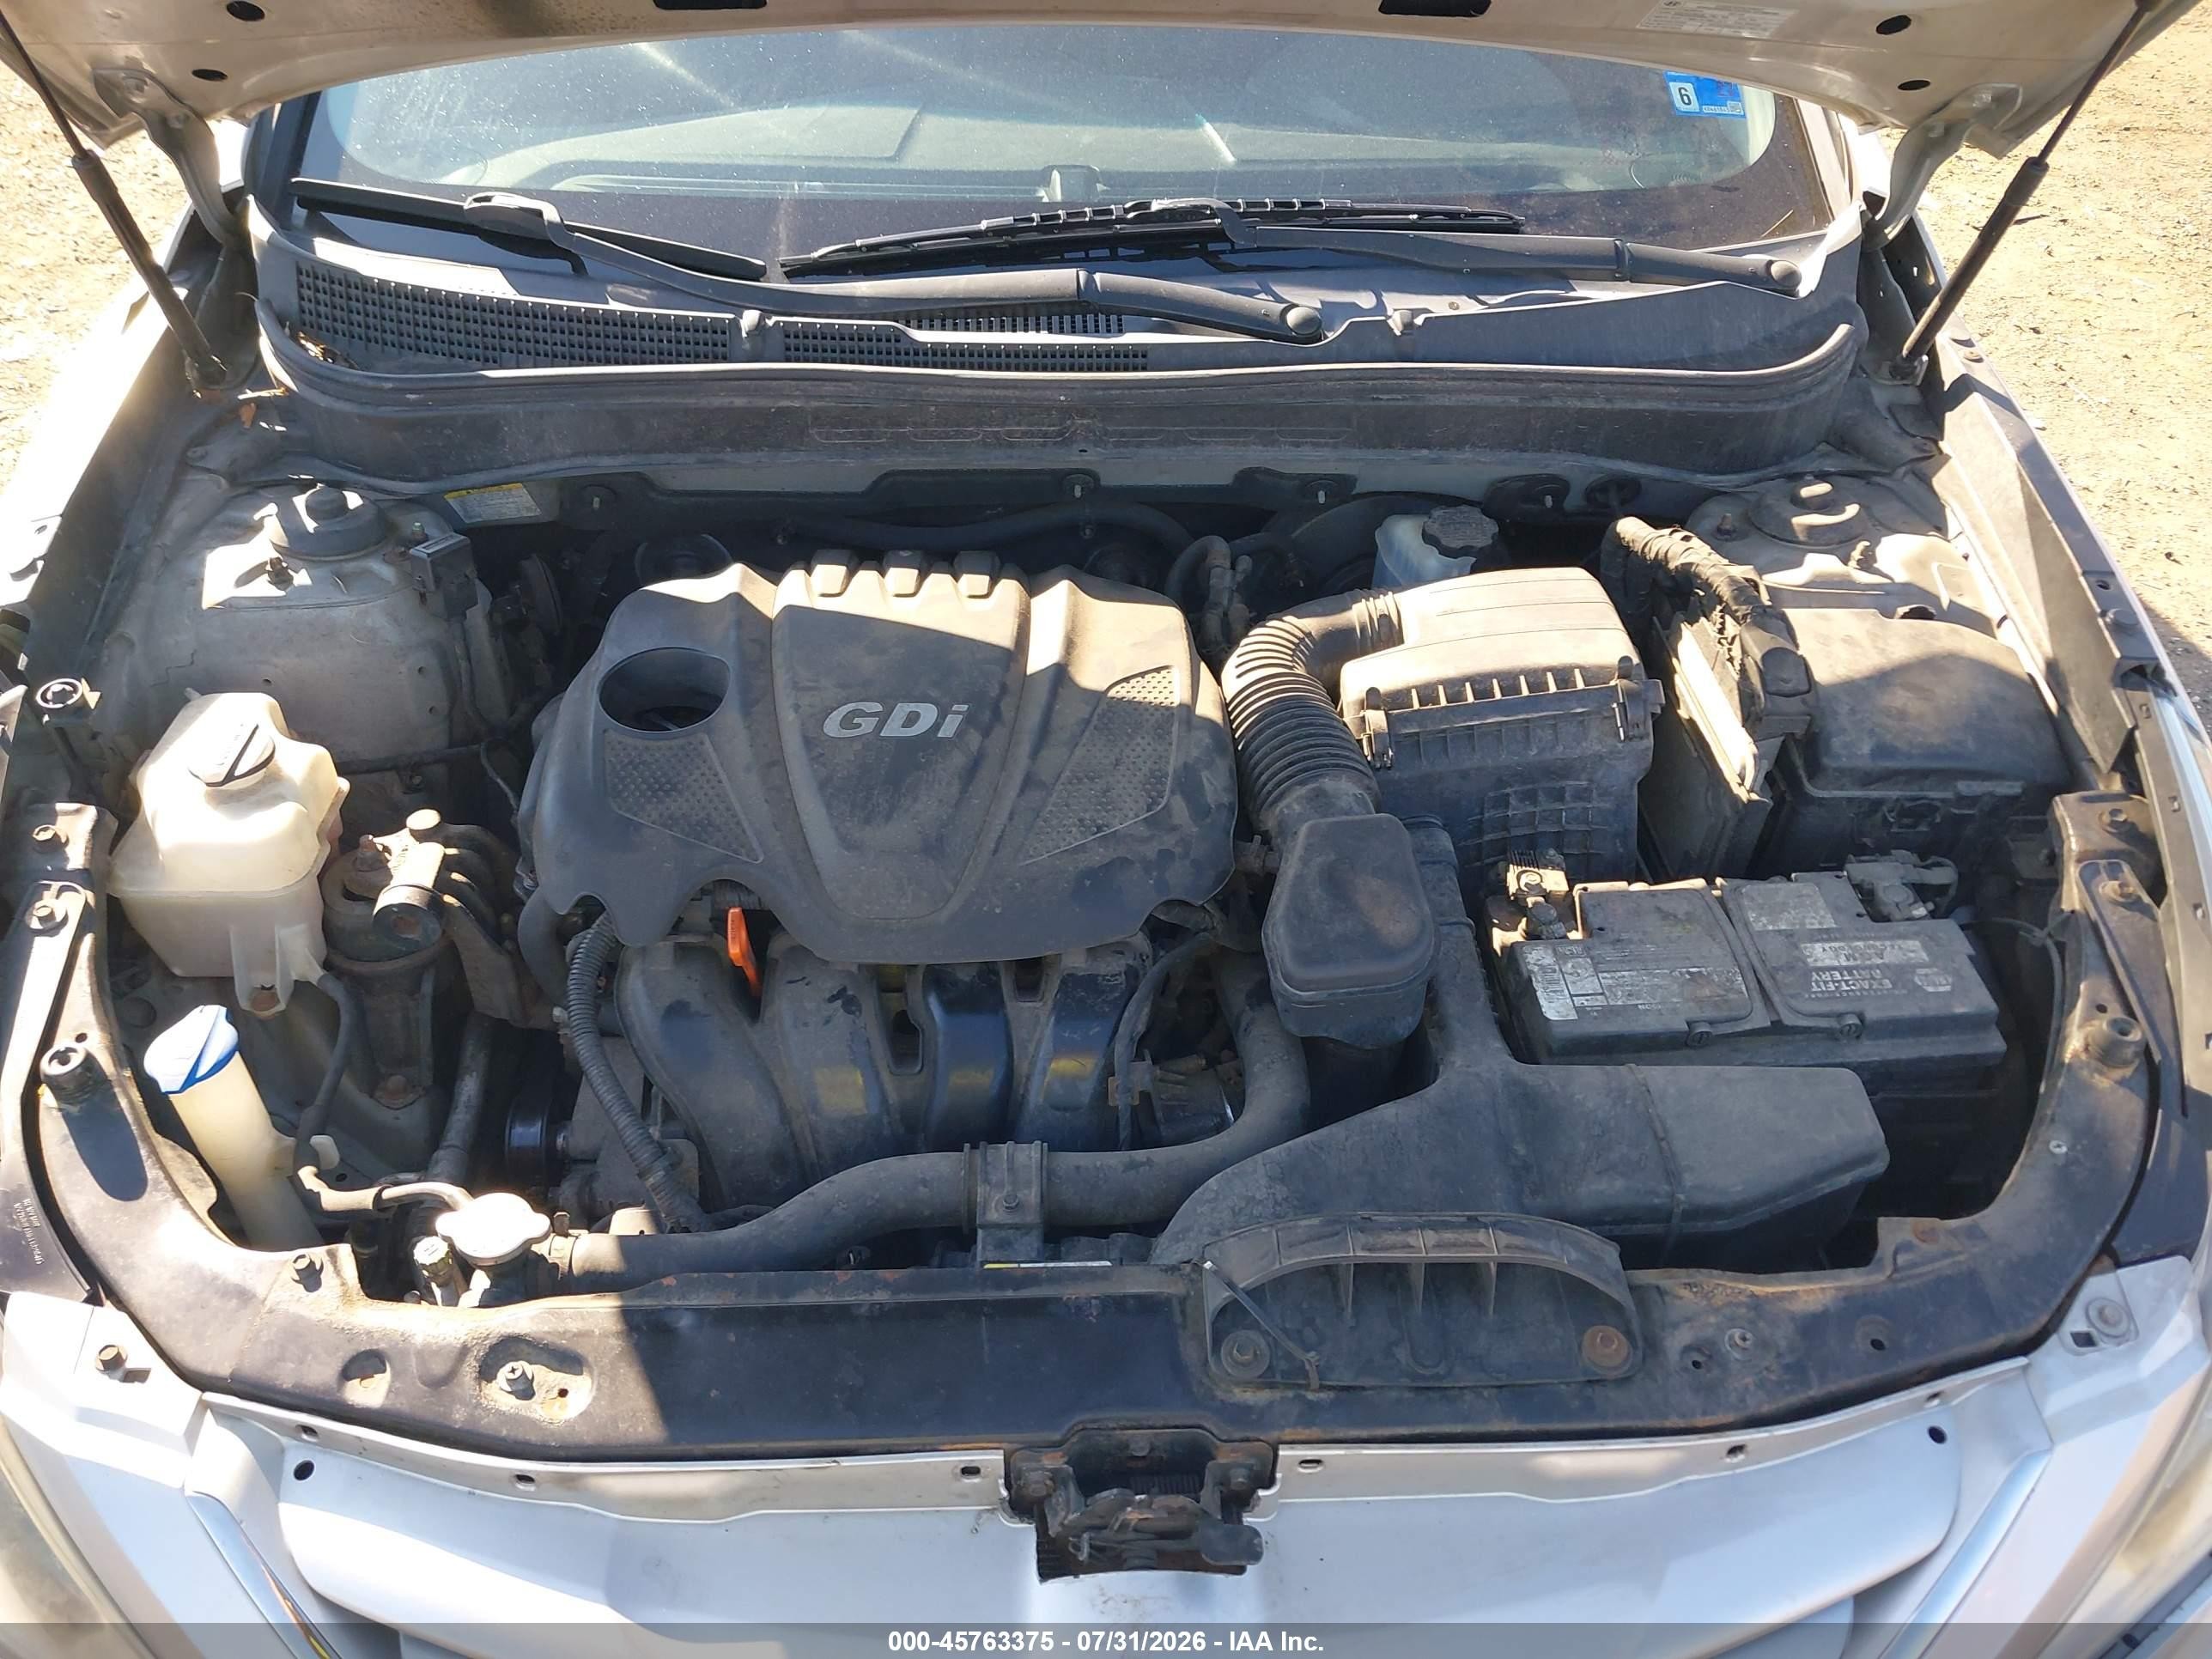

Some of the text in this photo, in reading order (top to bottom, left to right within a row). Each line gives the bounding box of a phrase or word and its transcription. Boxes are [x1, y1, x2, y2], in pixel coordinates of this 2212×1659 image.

[1677, 87, 1692, 106] 6
[822, 701, 969, 738] GDi
[1811, 969, 1883, 982] BATTERY
[1811, 978, 1893, 992] EXACT-FIT
